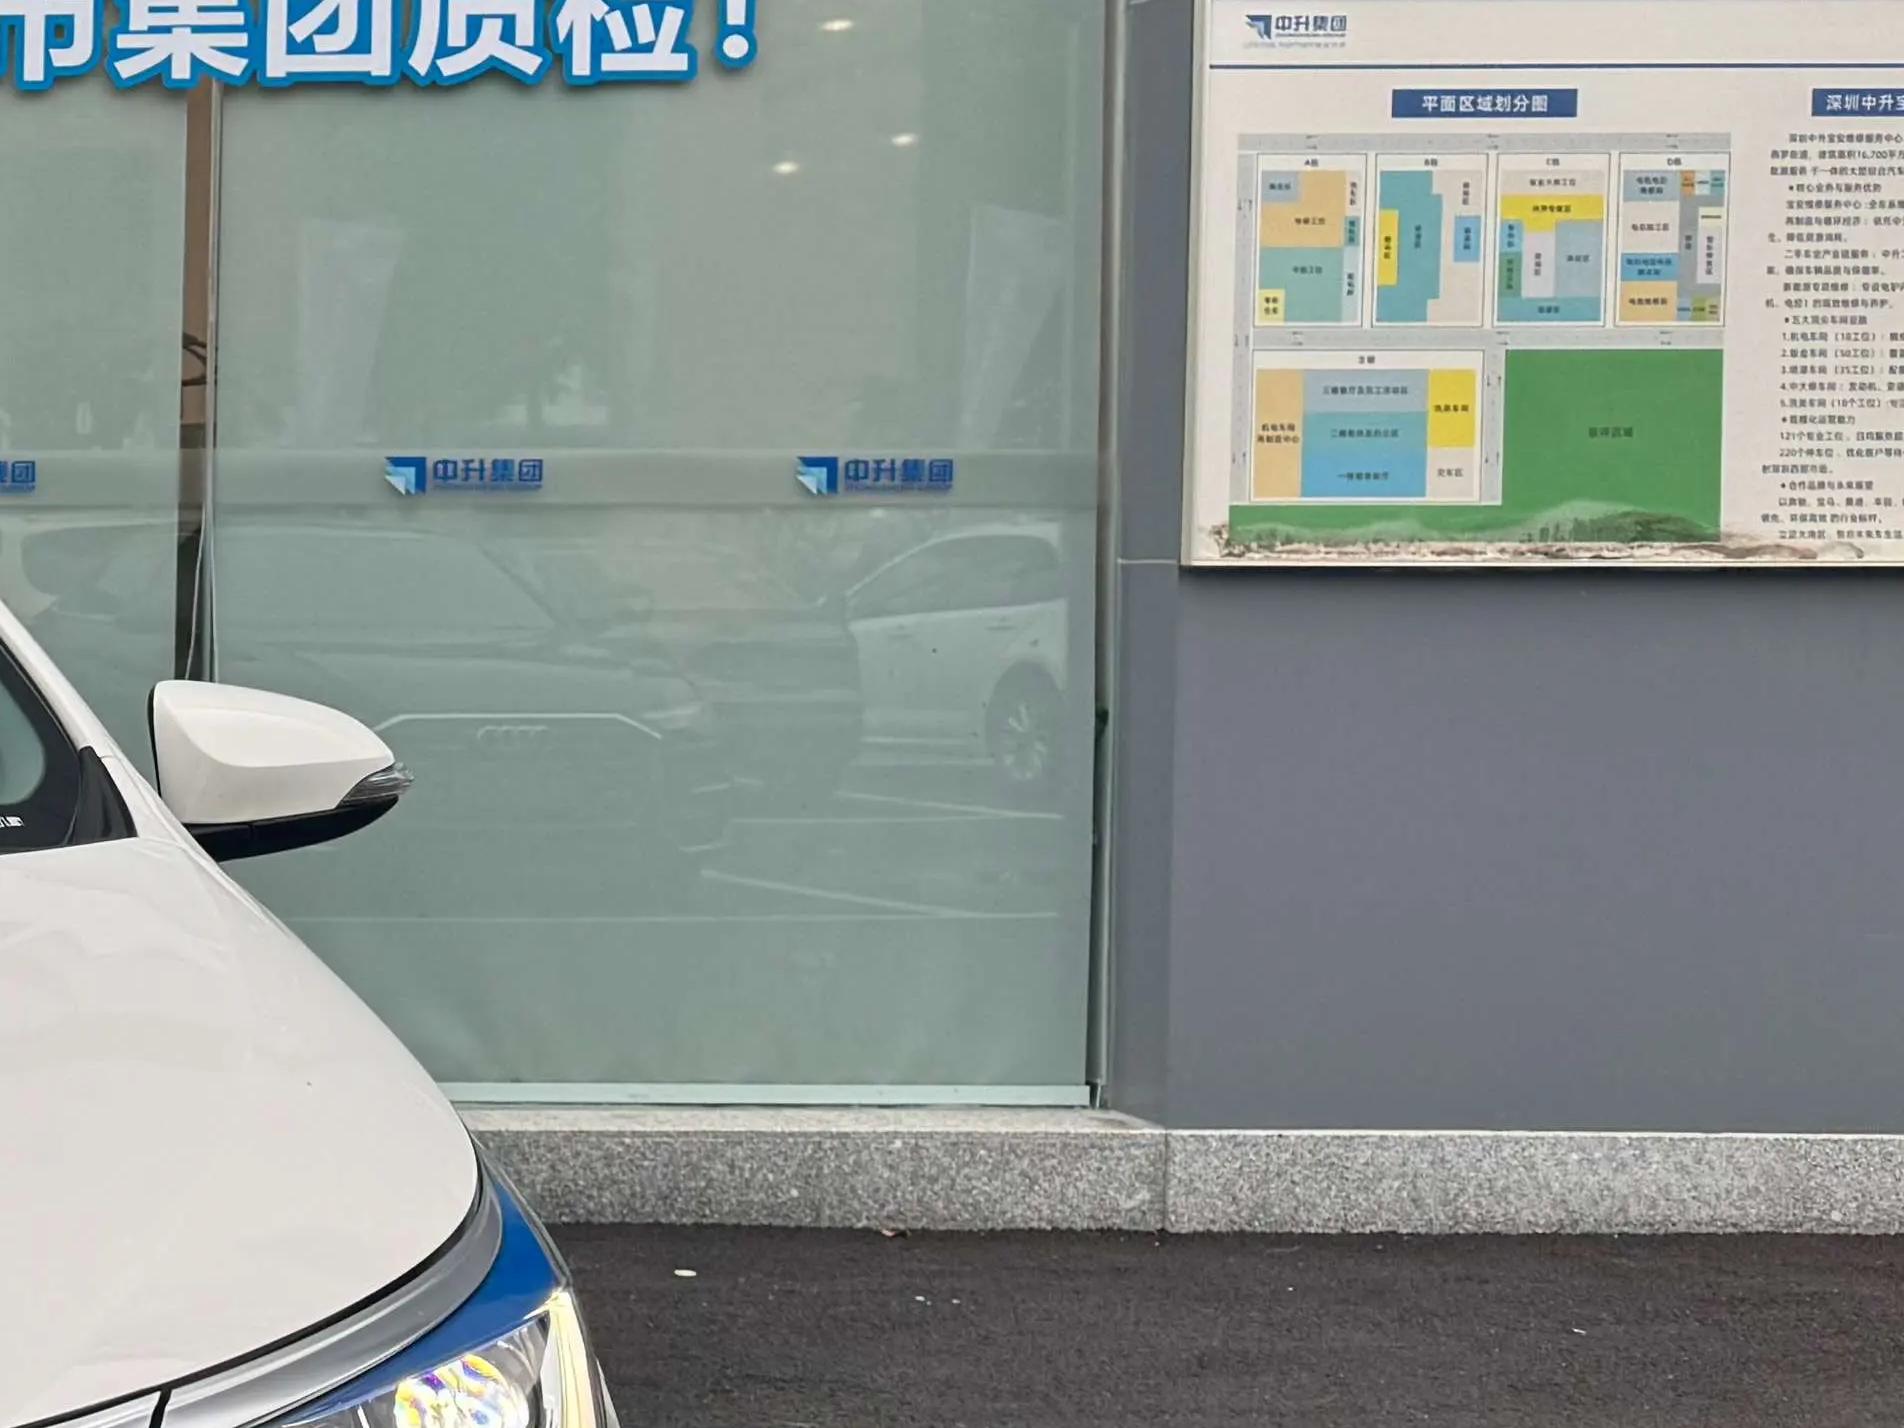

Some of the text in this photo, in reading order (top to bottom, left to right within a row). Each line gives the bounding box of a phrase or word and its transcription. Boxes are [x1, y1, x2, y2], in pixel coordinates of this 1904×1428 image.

[1275, 15, 1347, 32] 中升集团
[1422, 94, 1548, 112] 平面区域划分图
[433, 459, 543, 482] 中升集团
[845, 459, 953, 482] 中升集团
